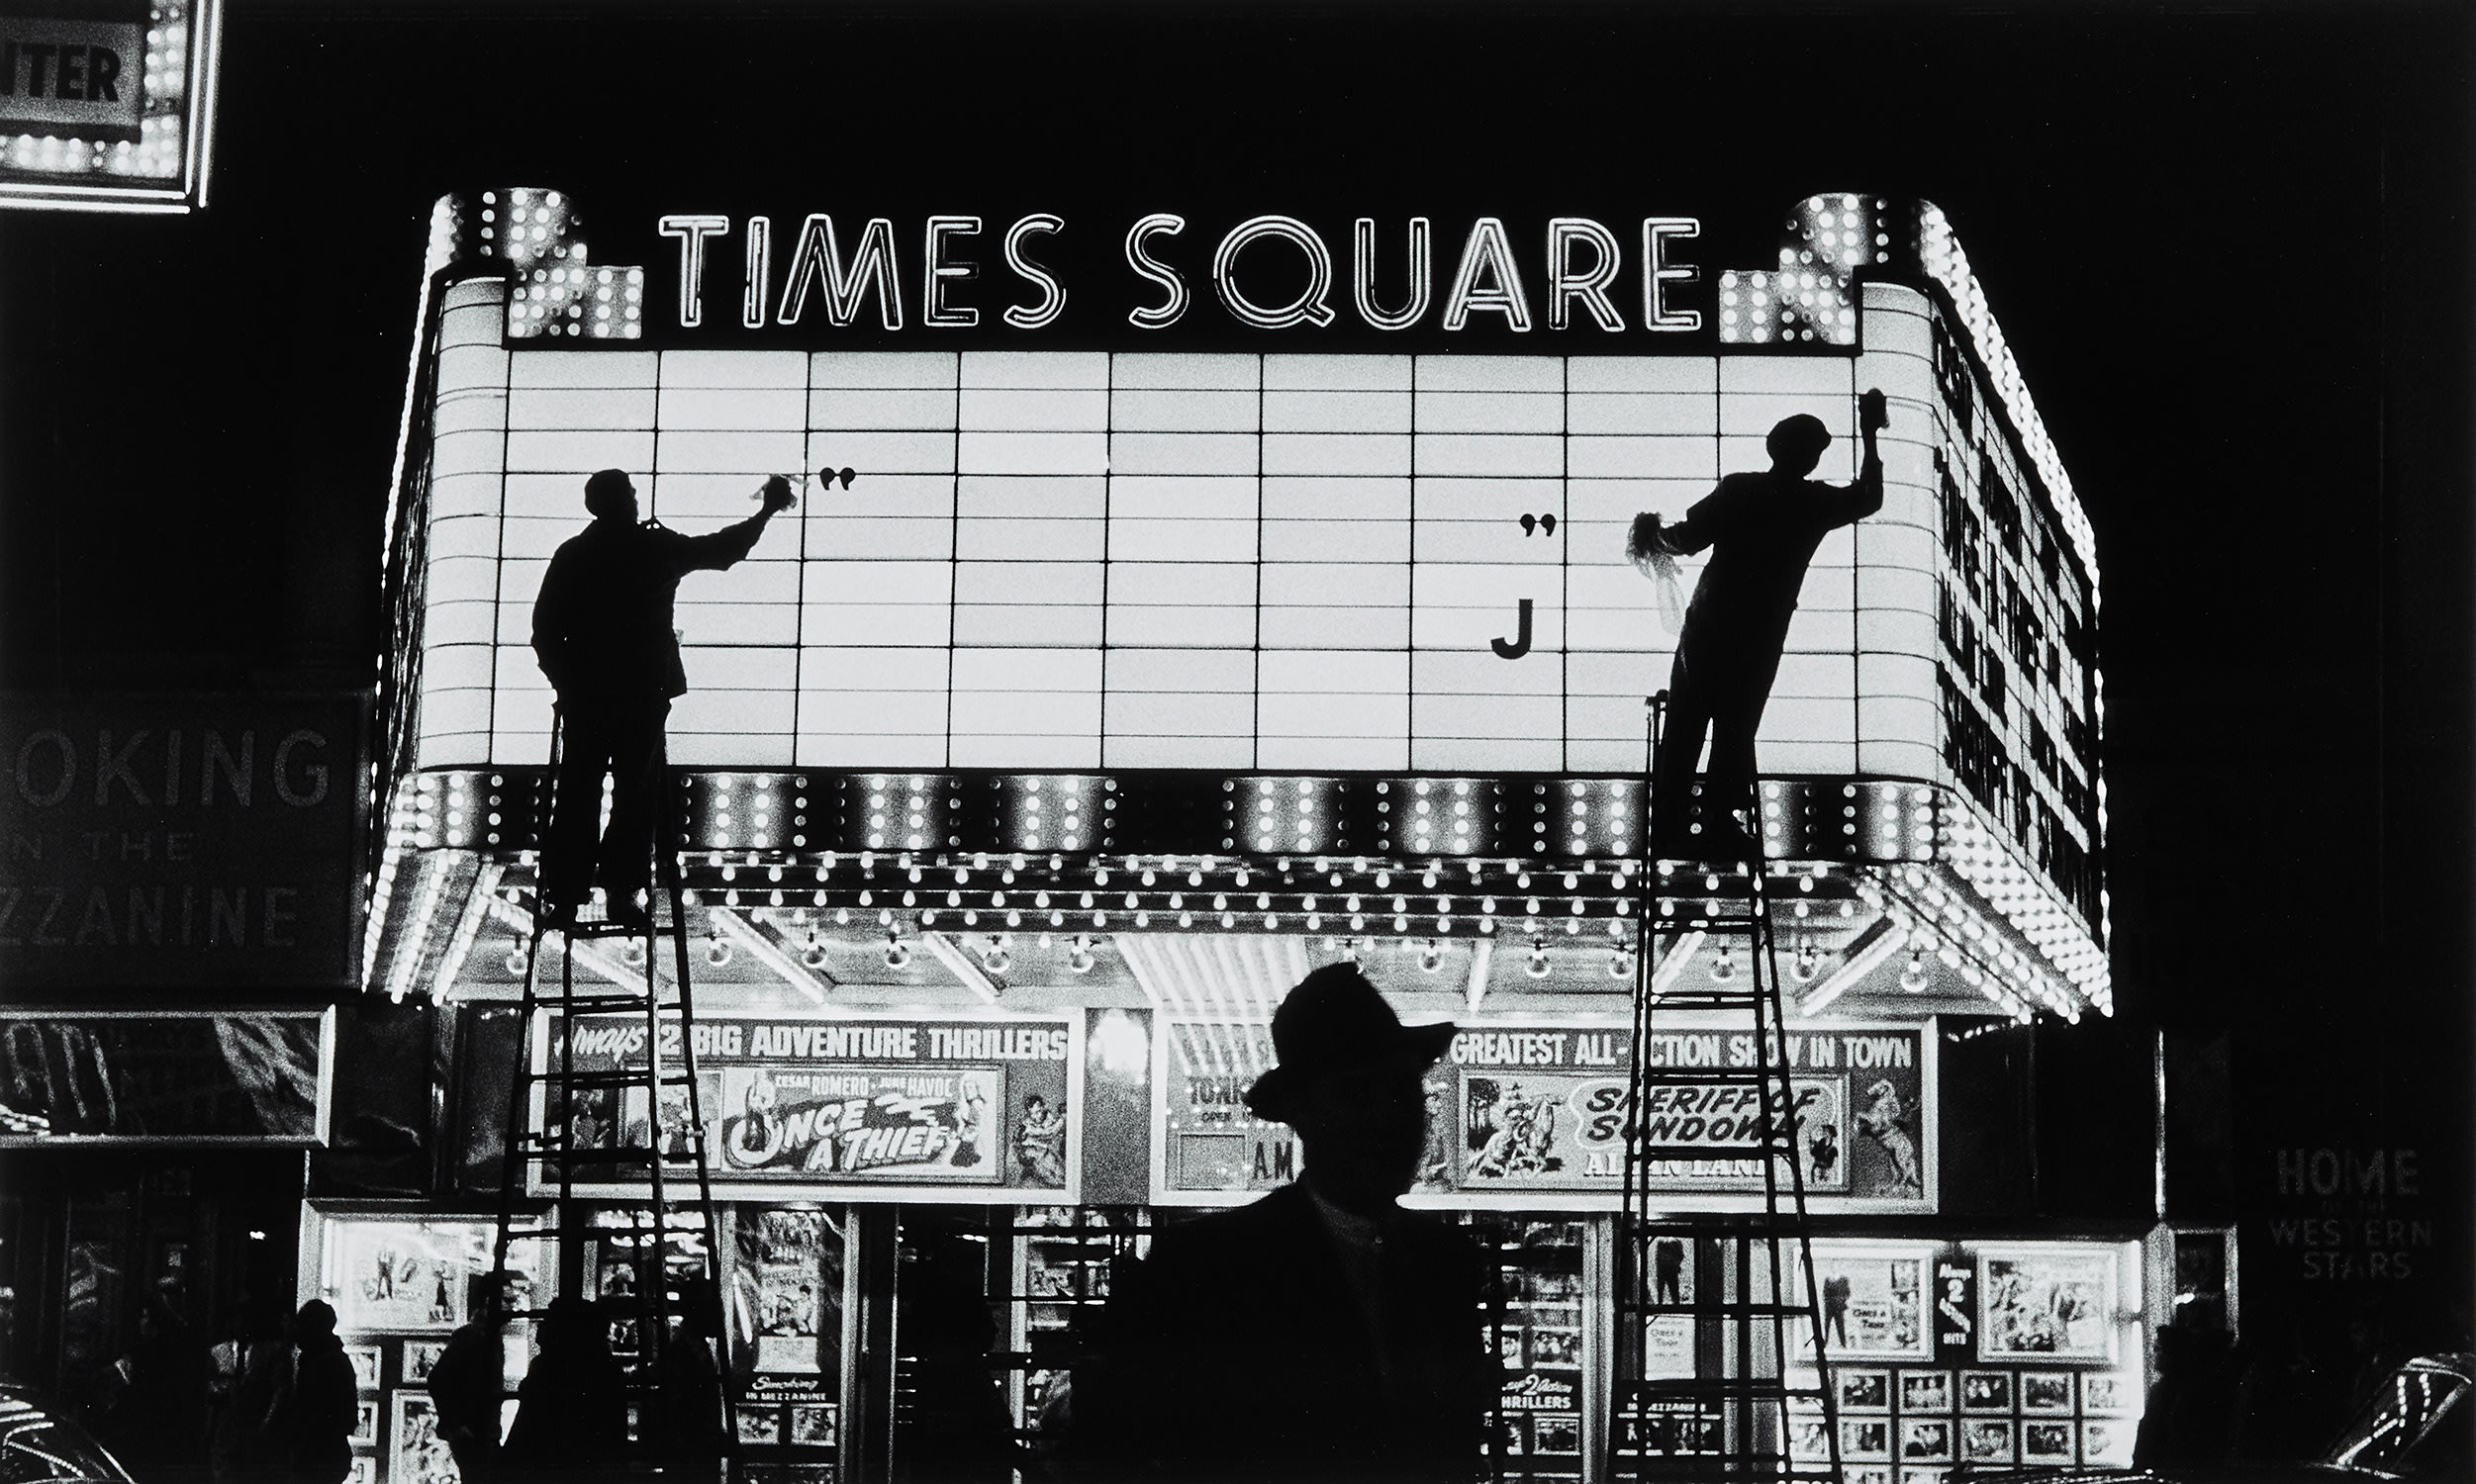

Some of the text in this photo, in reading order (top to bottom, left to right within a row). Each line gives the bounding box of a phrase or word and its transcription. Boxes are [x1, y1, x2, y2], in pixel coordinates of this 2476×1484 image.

[658, 213, 1702, 332] TIMES SQUARE
[1490, 599, 1534, 660] J
[83, 832, 196, 863] THE
[659, 1025, 682, 1056] 2
[689, 1025, 742, 1058] BIG
[750, 1025, 917, 1059] ADVENTURE
[927, 1028, 1069, 1061] THRILLERS
[1450, 1032, 1567, 1066] GREATEST
[1574, 1033, 1721, 1067] ALL-CTION
[1809, 1036, 1837, 1068] IN
[1844, 1037, 1912, 1068] TOWN
[810, 1075, 870, 1096] ROMERO
[906, 1076, 953, 1098] HAVOC
[1767, 1087, 1821, 1114] OF
[728, 1099, 869, 1165] ONCE
[807, 1126, 950, 1172] A THIEF
[2276, 1147, 2420, 1196] HOME
[1947, 1278, 1964, 1303] 2
[751, 1375, 819, 1392] Smoking
[760, 1391, 827, 1403] MEZZANINE
[1522, 1373, 1540, 1396] 2
